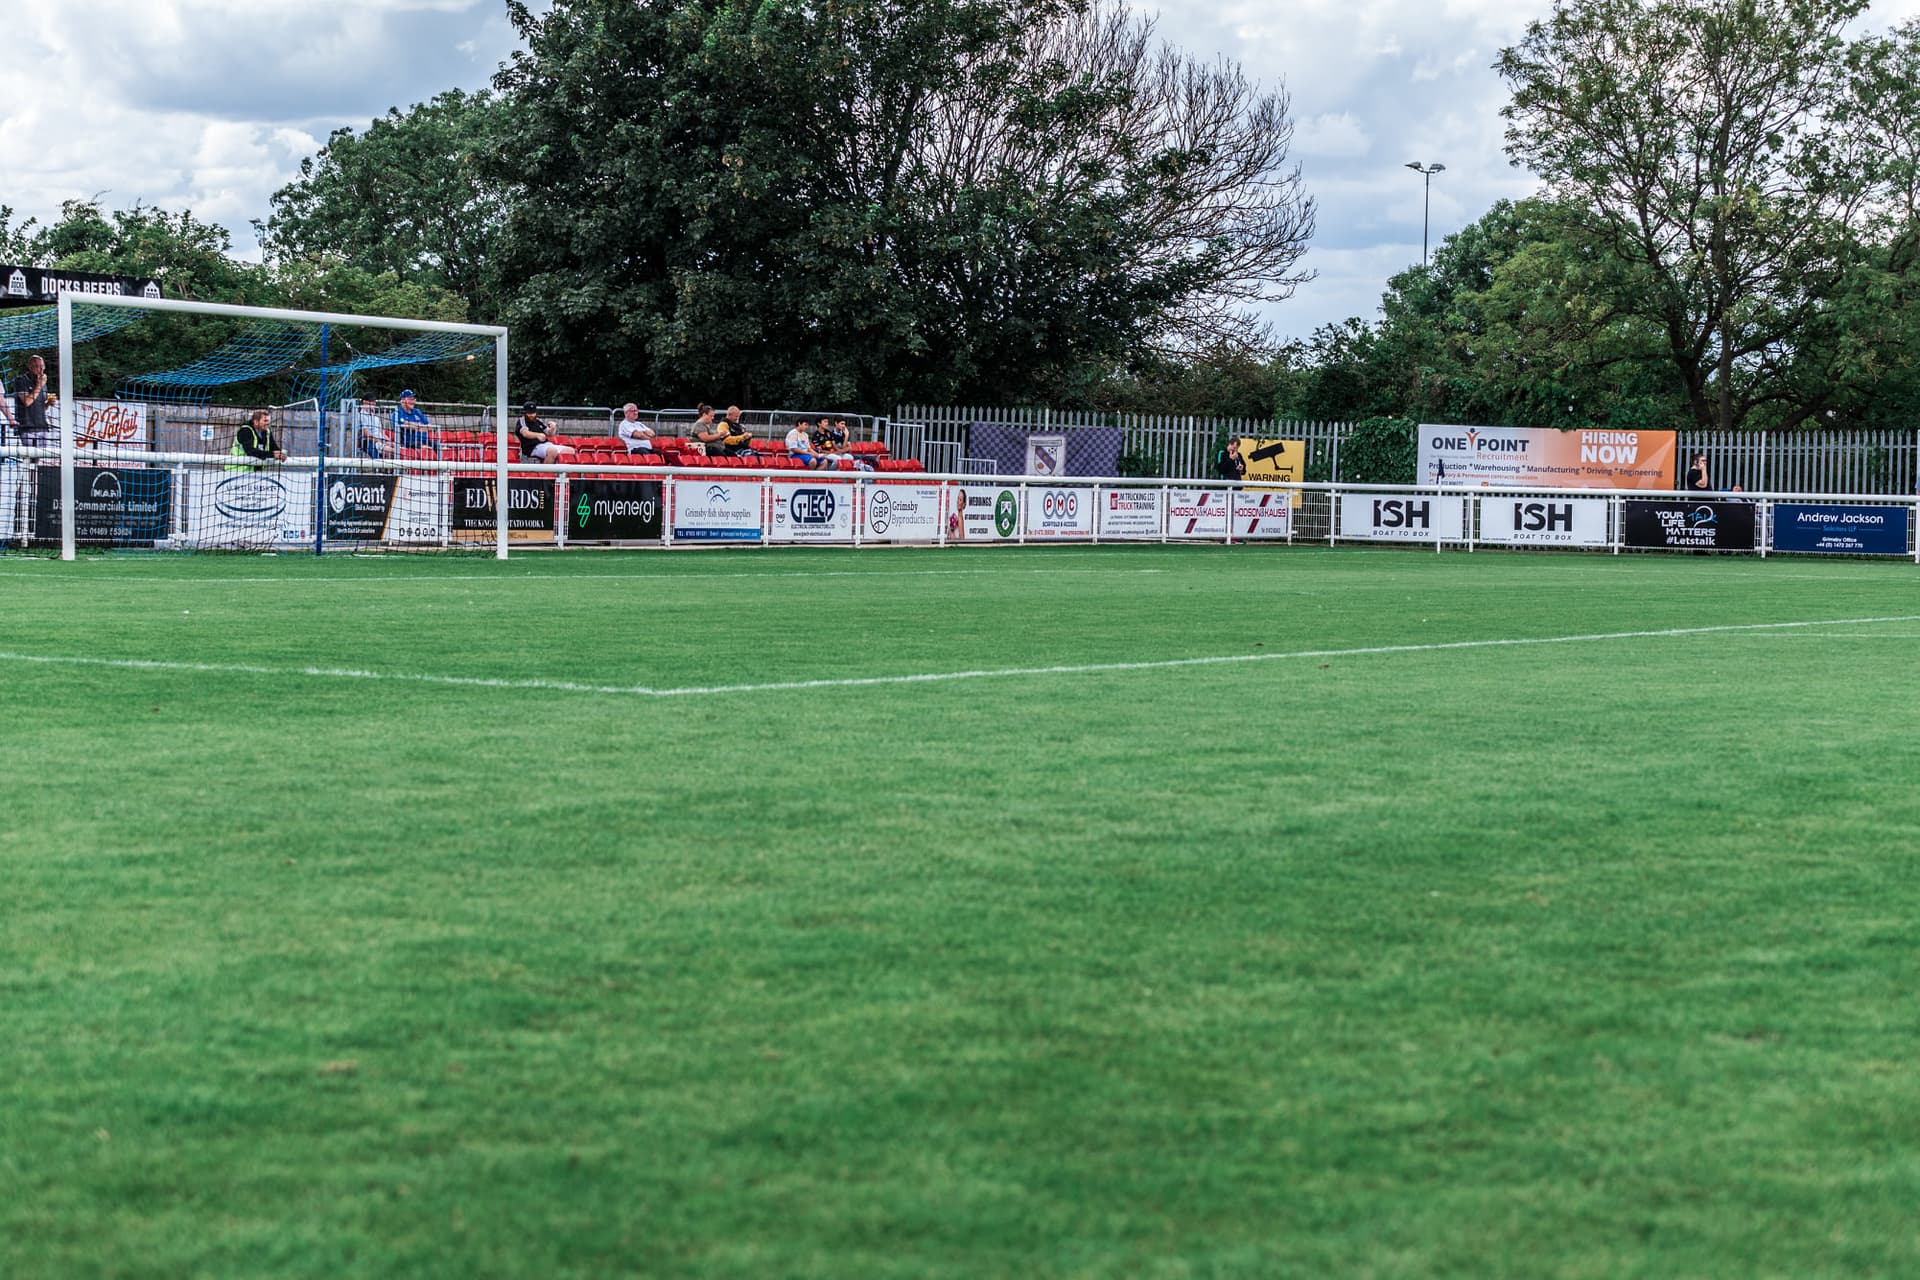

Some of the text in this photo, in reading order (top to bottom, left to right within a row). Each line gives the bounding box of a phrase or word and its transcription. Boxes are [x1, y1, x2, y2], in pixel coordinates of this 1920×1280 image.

[41, 276, 121, 296] DOCKS BEERS
[1432, 437, 1530, 452] ONE POINT
[1581, 431, 1639, 445] HIRING
[1476, 452, 1529, 461] Recruitment
[1581, 445, 1639, 465] NOW
[1248, 473, 1291, 482] WARNING
[1473, 464, 1521, 473] Warehousing
[1526, 465, 1581, 475] Manufacturing
[1586, 467, 1613, 476] Driving
[1619, 468, 1664, 478] Engineering
[346, 484, 387, 504] avant
[1125, 492, 1147, 502] TRUCKING
[128, 501, 158, 512] Limited
[594, 496, 655, 523] myenergi
[873, 506, 889, 518] GBP
[892, 500, 919, 514] Grimsby
[1373, 499, 1430, 528] ISH
[1514, 503, 1573, 532] ISH
[1655, 511, 1684, 520] YOUR
[1797, 512, 1884, 524] Andrew Jackson
[891, 514, 926, 527] Byproducts
[1661, 519, 1686, 528] LIFE
[1666, 527, 1717, 537] MATTERS
[1666, 536, 1716, 546] #Letstalk
